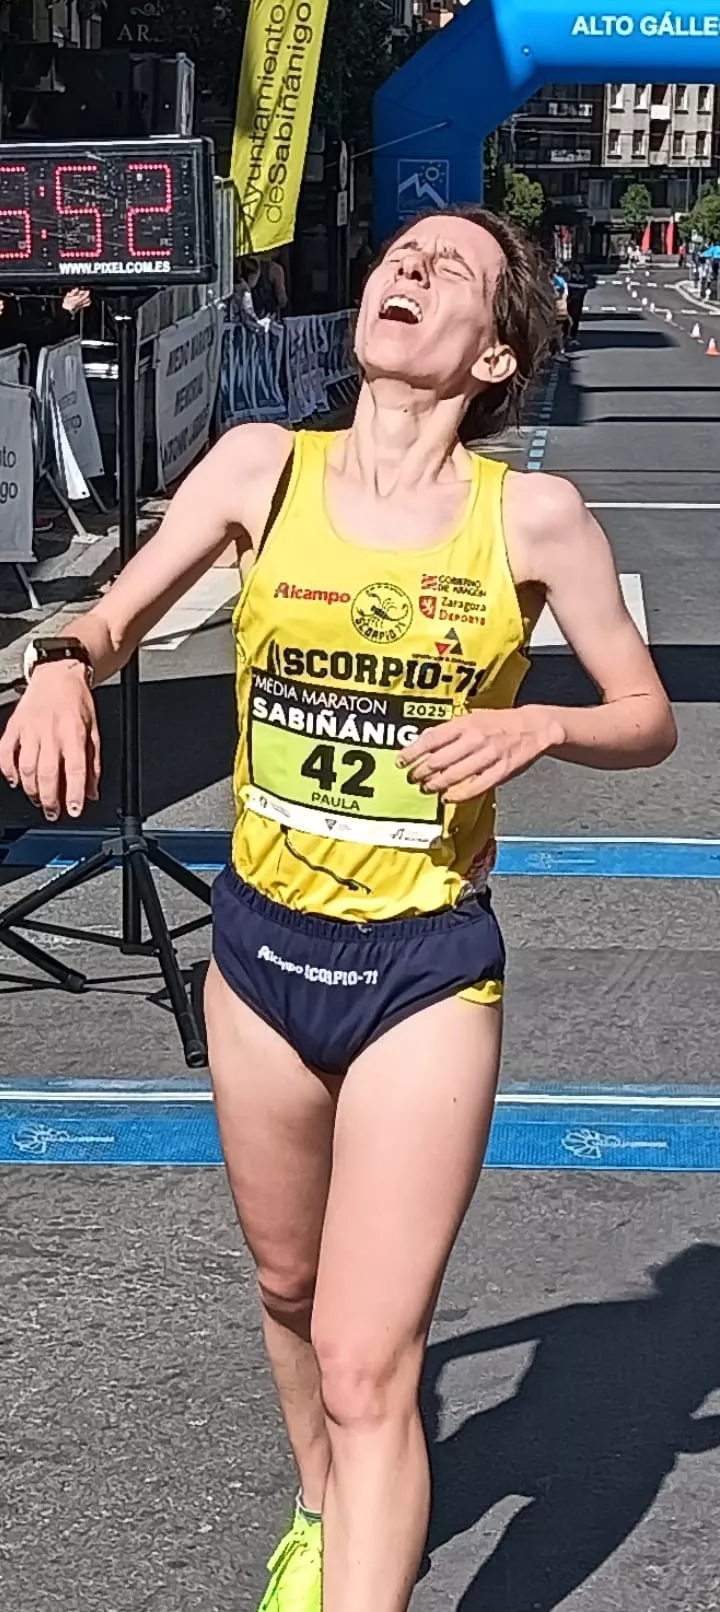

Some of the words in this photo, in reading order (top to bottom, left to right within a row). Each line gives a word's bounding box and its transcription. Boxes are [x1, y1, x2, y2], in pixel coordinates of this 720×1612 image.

[571, 15, 634, 36] ALTO
[639, 10, 720, 36] GÁLLE
[239, 5, 286, 222] Ayuntamiento
[441, 596, 487, 613] Zaragoza
[254, 677, 298, 699] MEDIA
[302, 688, 388, 716] MARATON
[406, 704, 447, 718] 2025
[252, 696, 419, 747] SABIÑÁNIG
[301, 744, 376, 798] 42
[311, 791, 360, 812] PAULA
